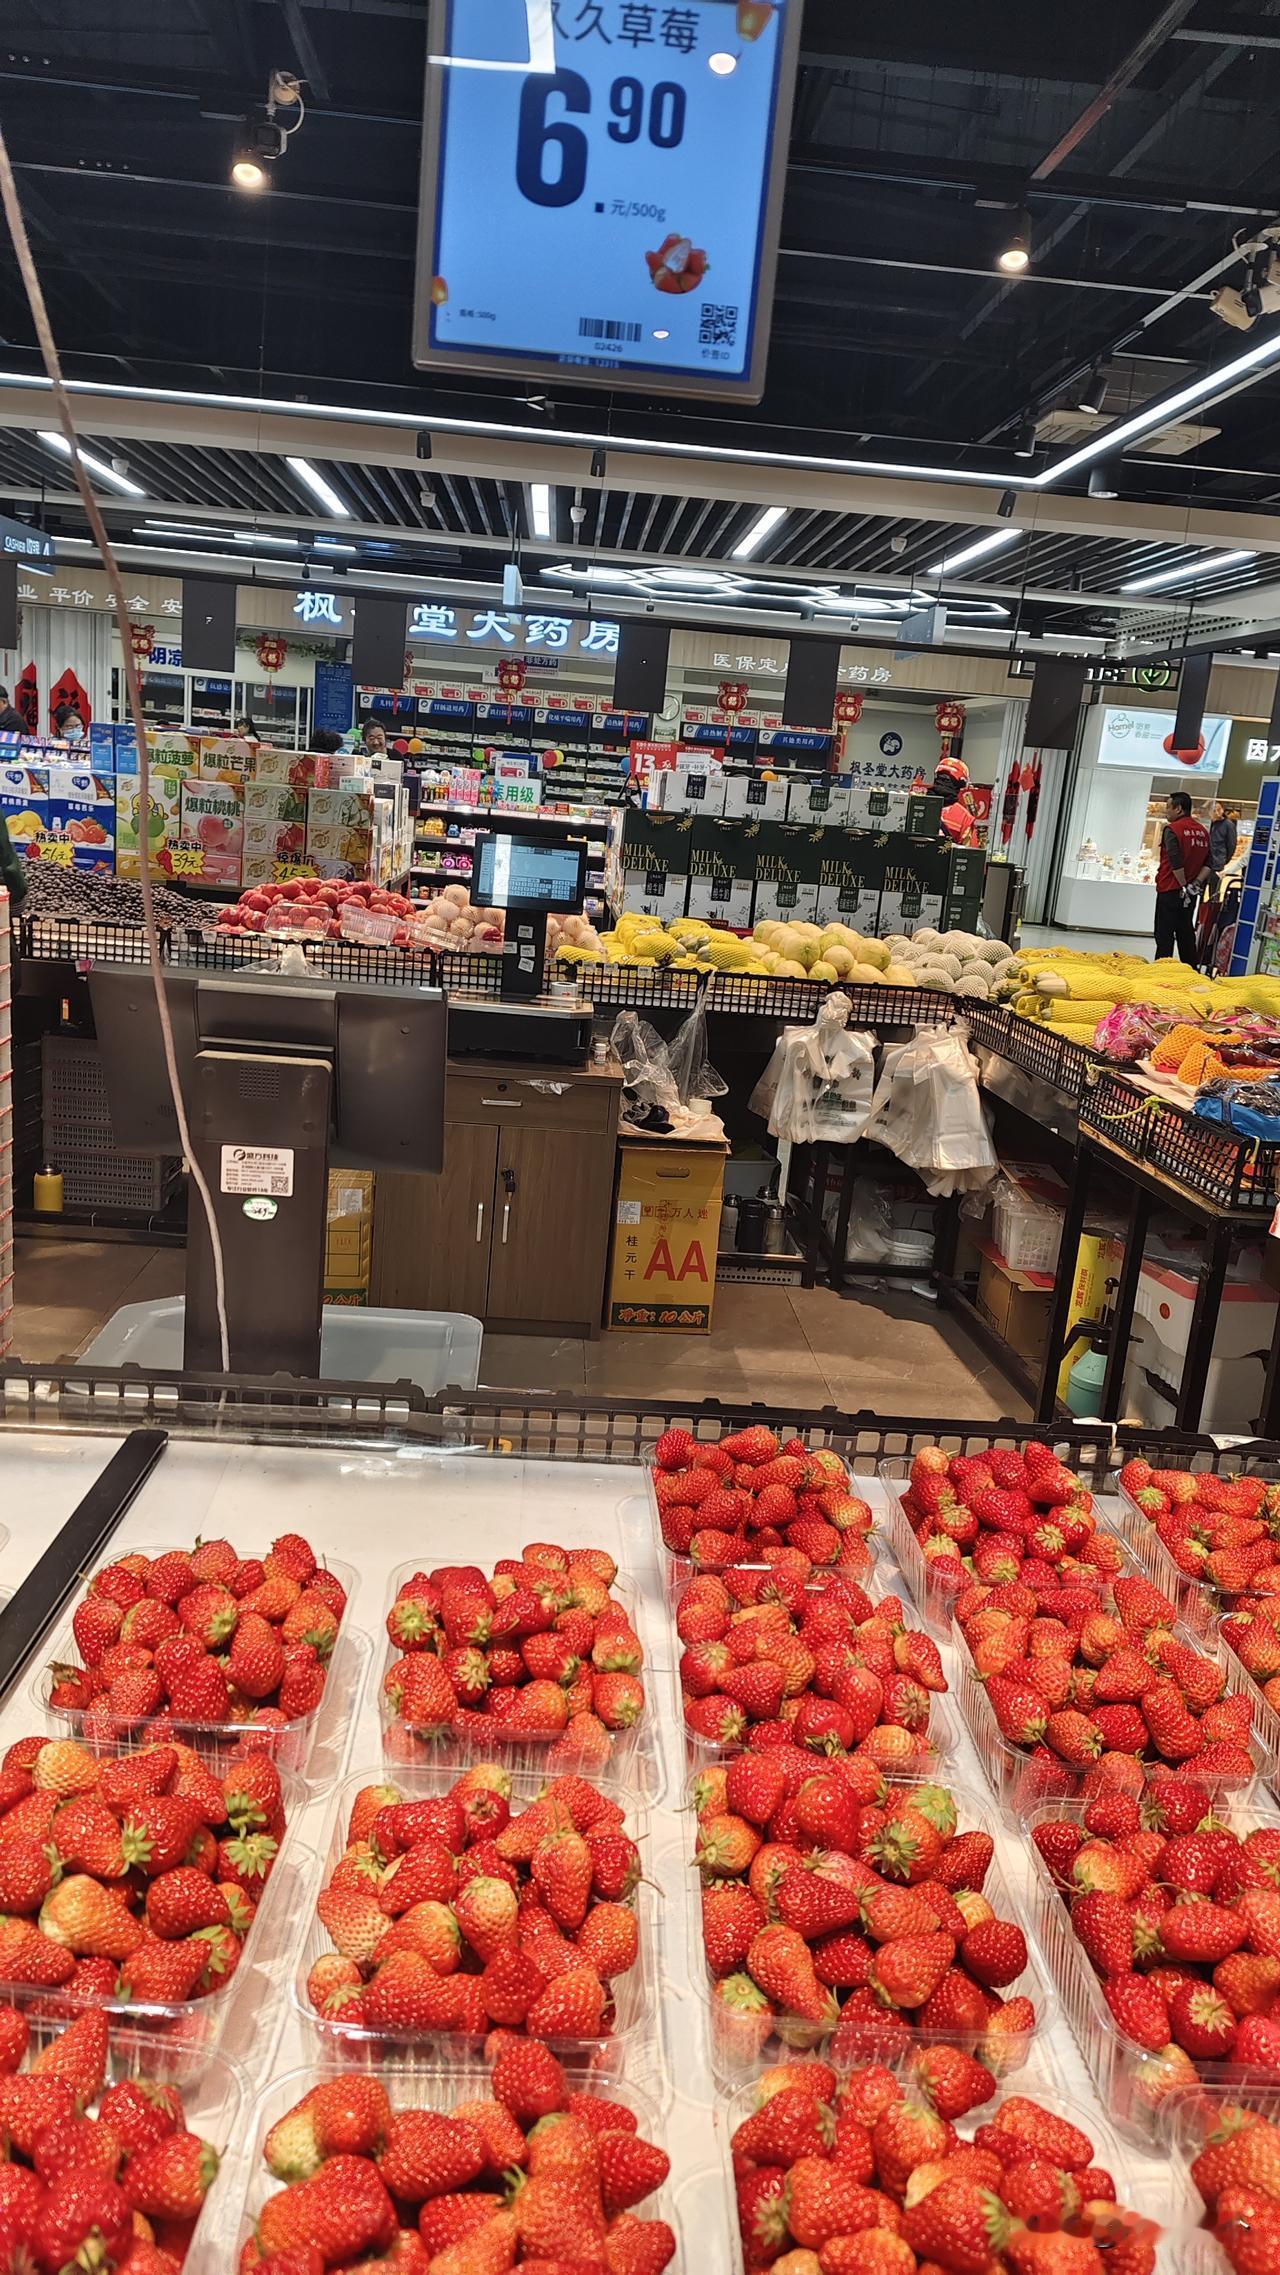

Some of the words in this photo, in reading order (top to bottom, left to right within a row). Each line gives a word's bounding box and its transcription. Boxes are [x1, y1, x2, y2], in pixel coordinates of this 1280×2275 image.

[610, 200, 666, 222] 元/500g
[50, 587, 94, 606] 平价
[634, 753, 656, 774] 13
[35, 831, 71, 843] 热卖中
[168, 839, 202, 851] 热卖中
[623, 842, 653, 858] MILK
[691, 849, 721, 864] MILK
[623, 856, 669, 872] DELUXE
[756, 854, 786, 869] MILK
[821, 859, 850, 874] MILK
[690, 862, 737, 878] DELUXE
[755, 867, 801, 883] DELUXE
[885, 866, 914, 881] MILK
[820, 872, 865, 888] DELUXE
[884, 878, 930, 894] DELUXE
[624, 1234, 639, 1281] 桂元干
[643, 1238, 709, 1283] AA
